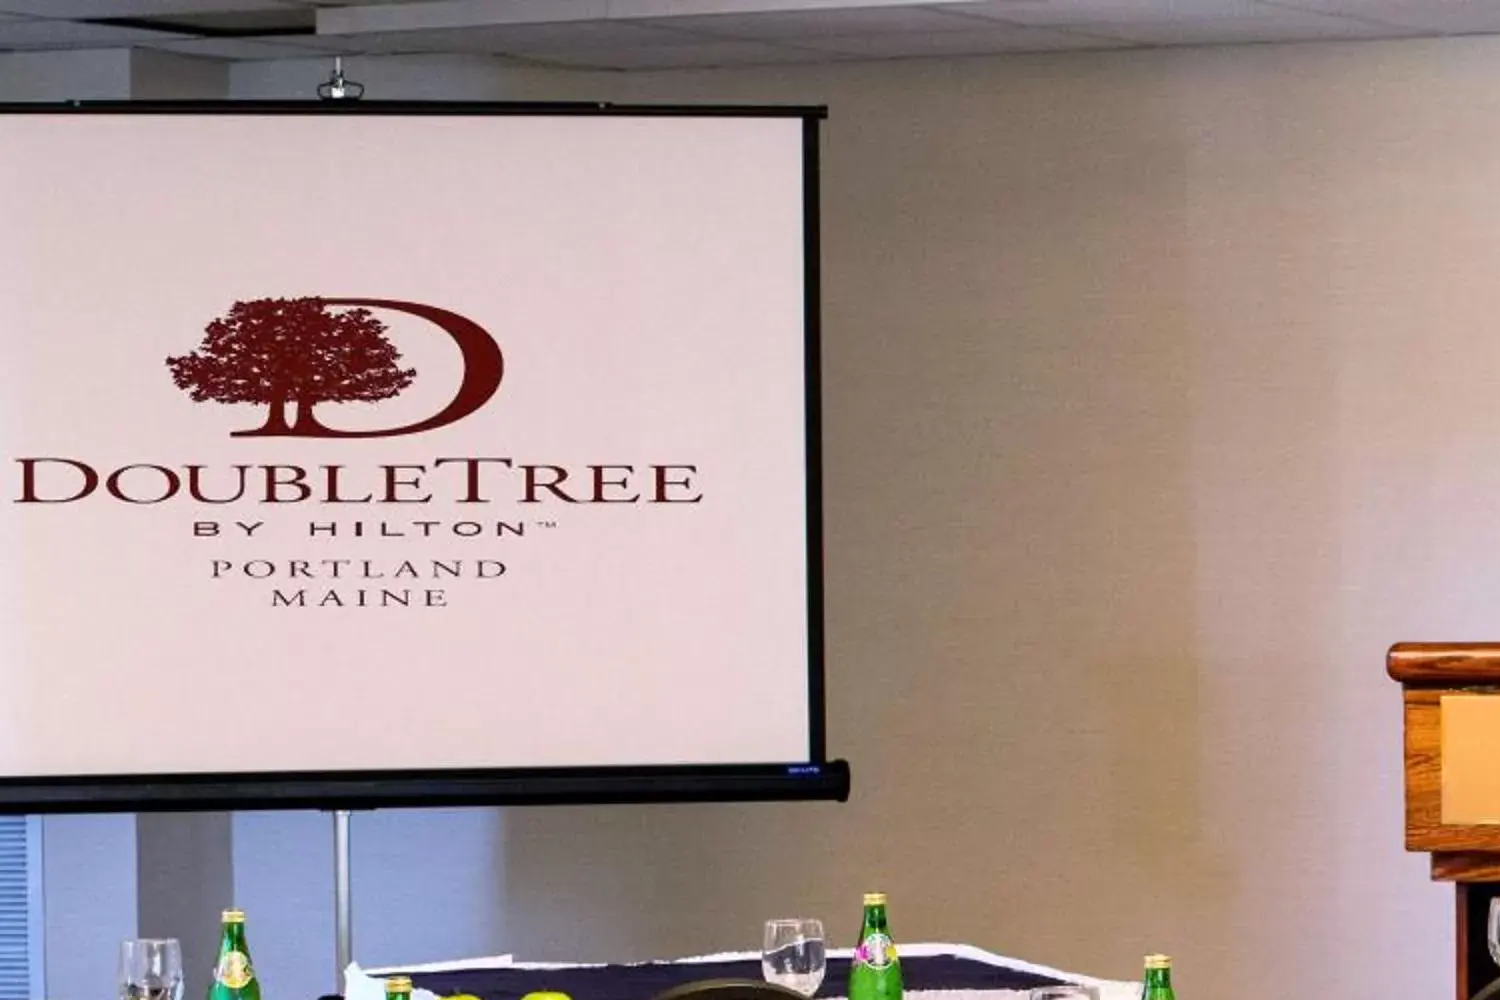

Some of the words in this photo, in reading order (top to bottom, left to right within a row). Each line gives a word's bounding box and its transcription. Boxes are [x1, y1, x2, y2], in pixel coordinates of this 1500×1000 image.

[193, 521, 265, 537] BY
[211, 559, 508, 579] PORTLAND
[271, 589, 448, 607] MAINE
